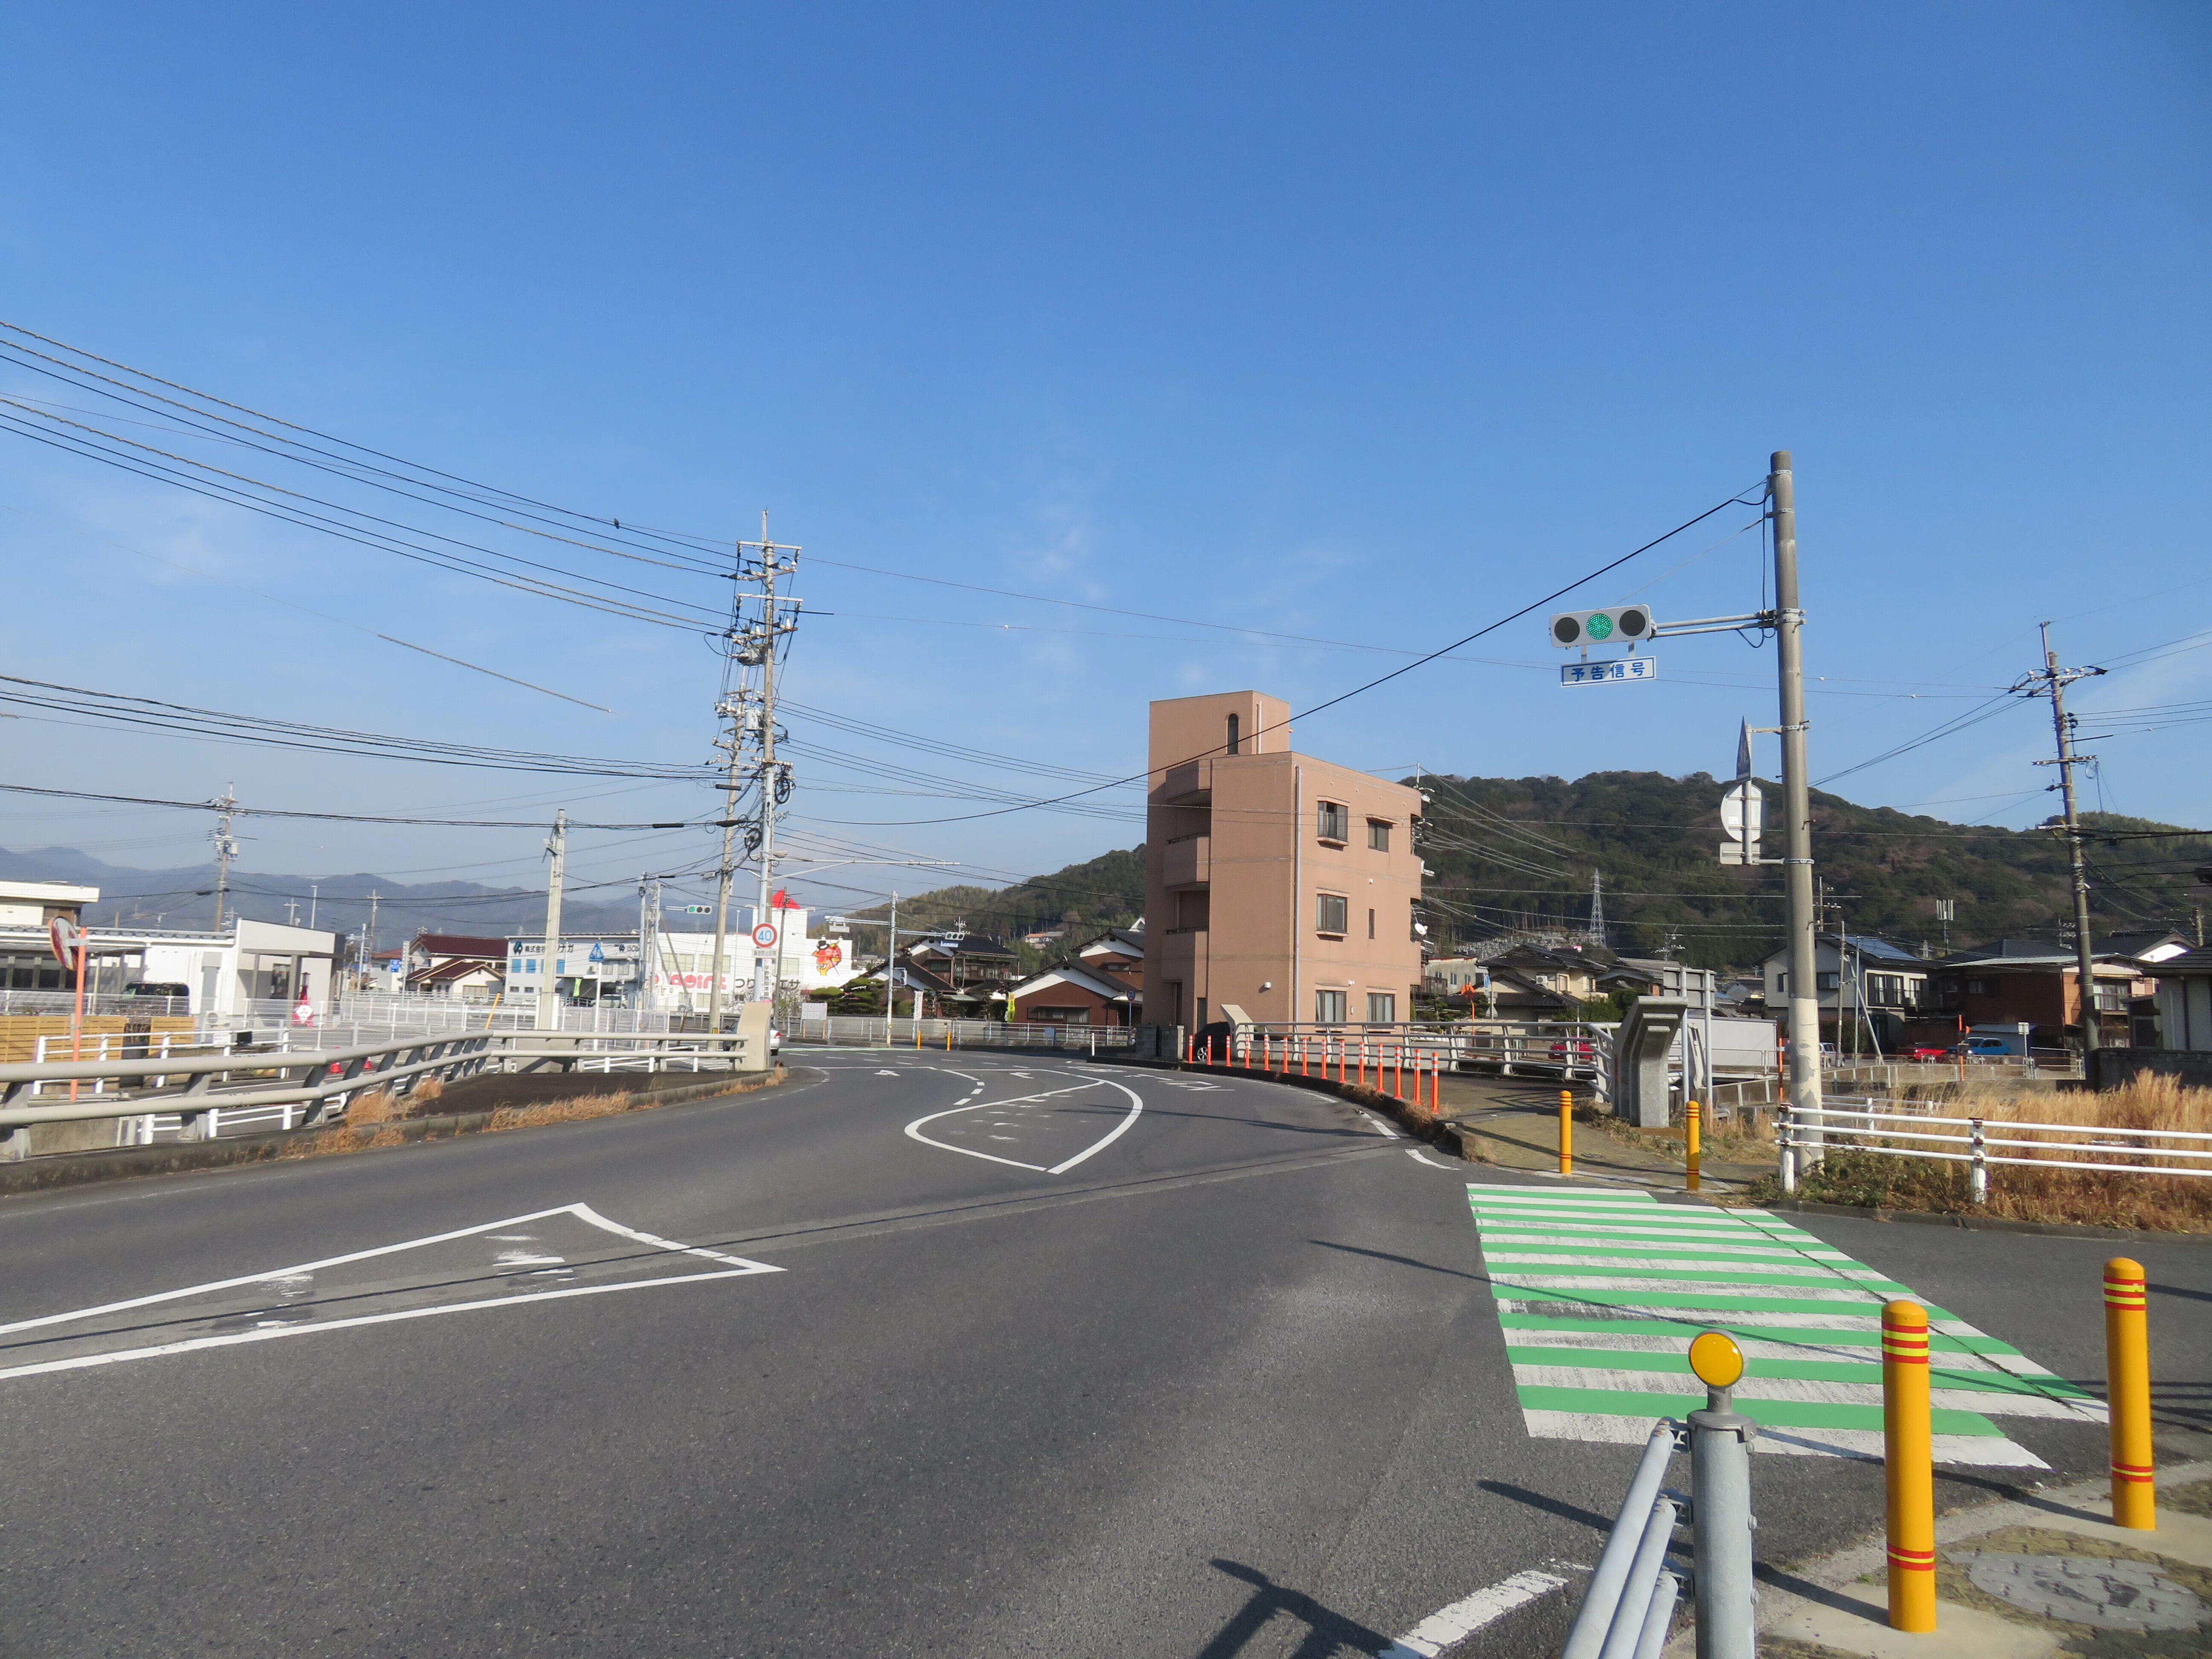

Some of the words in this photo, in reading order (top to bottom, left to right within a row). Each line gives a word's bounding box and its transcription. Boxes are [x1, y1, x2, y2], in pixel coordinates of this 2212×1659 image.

[1571, 662, 1645, 682] 予告信号
[758, 930, 771, 941] 40
